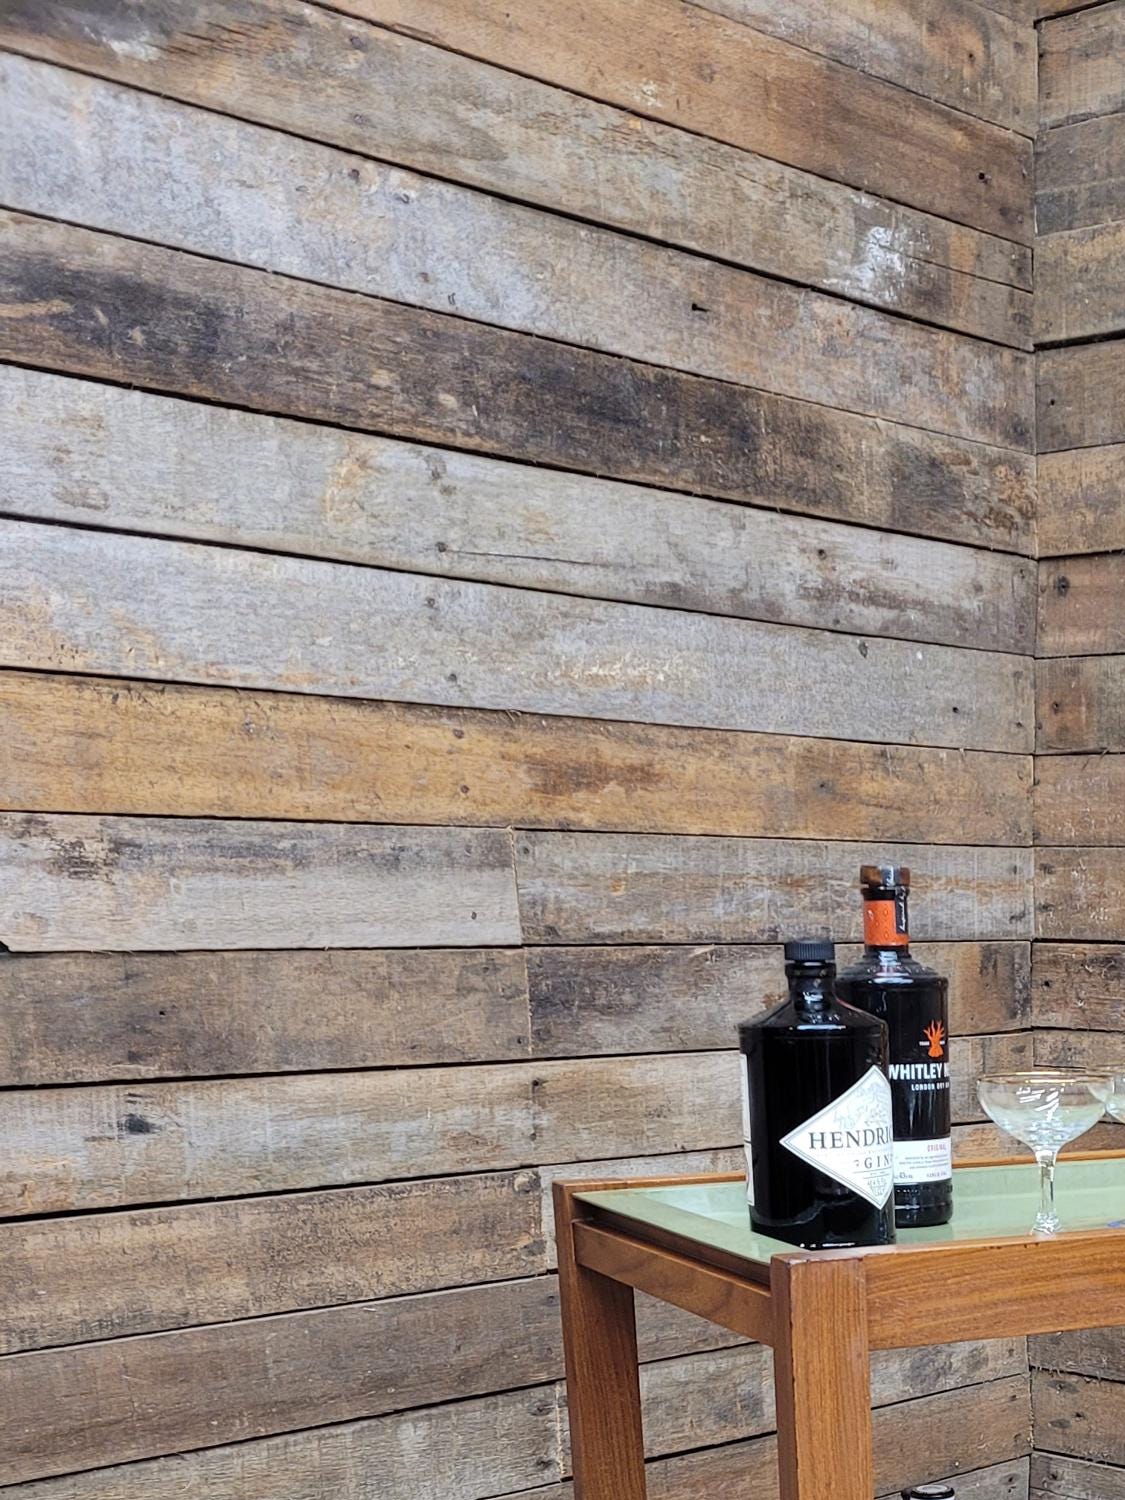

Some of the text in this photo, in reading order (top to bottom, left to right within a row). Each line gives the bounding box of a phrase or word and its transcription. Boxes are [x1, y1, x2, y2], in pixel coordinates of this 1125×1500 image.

[888, 1063, 943, 1080] WHITLEY
[911, 1083, 936, 1092] LONDON
[864, 1154, 890, 1169] GIN
